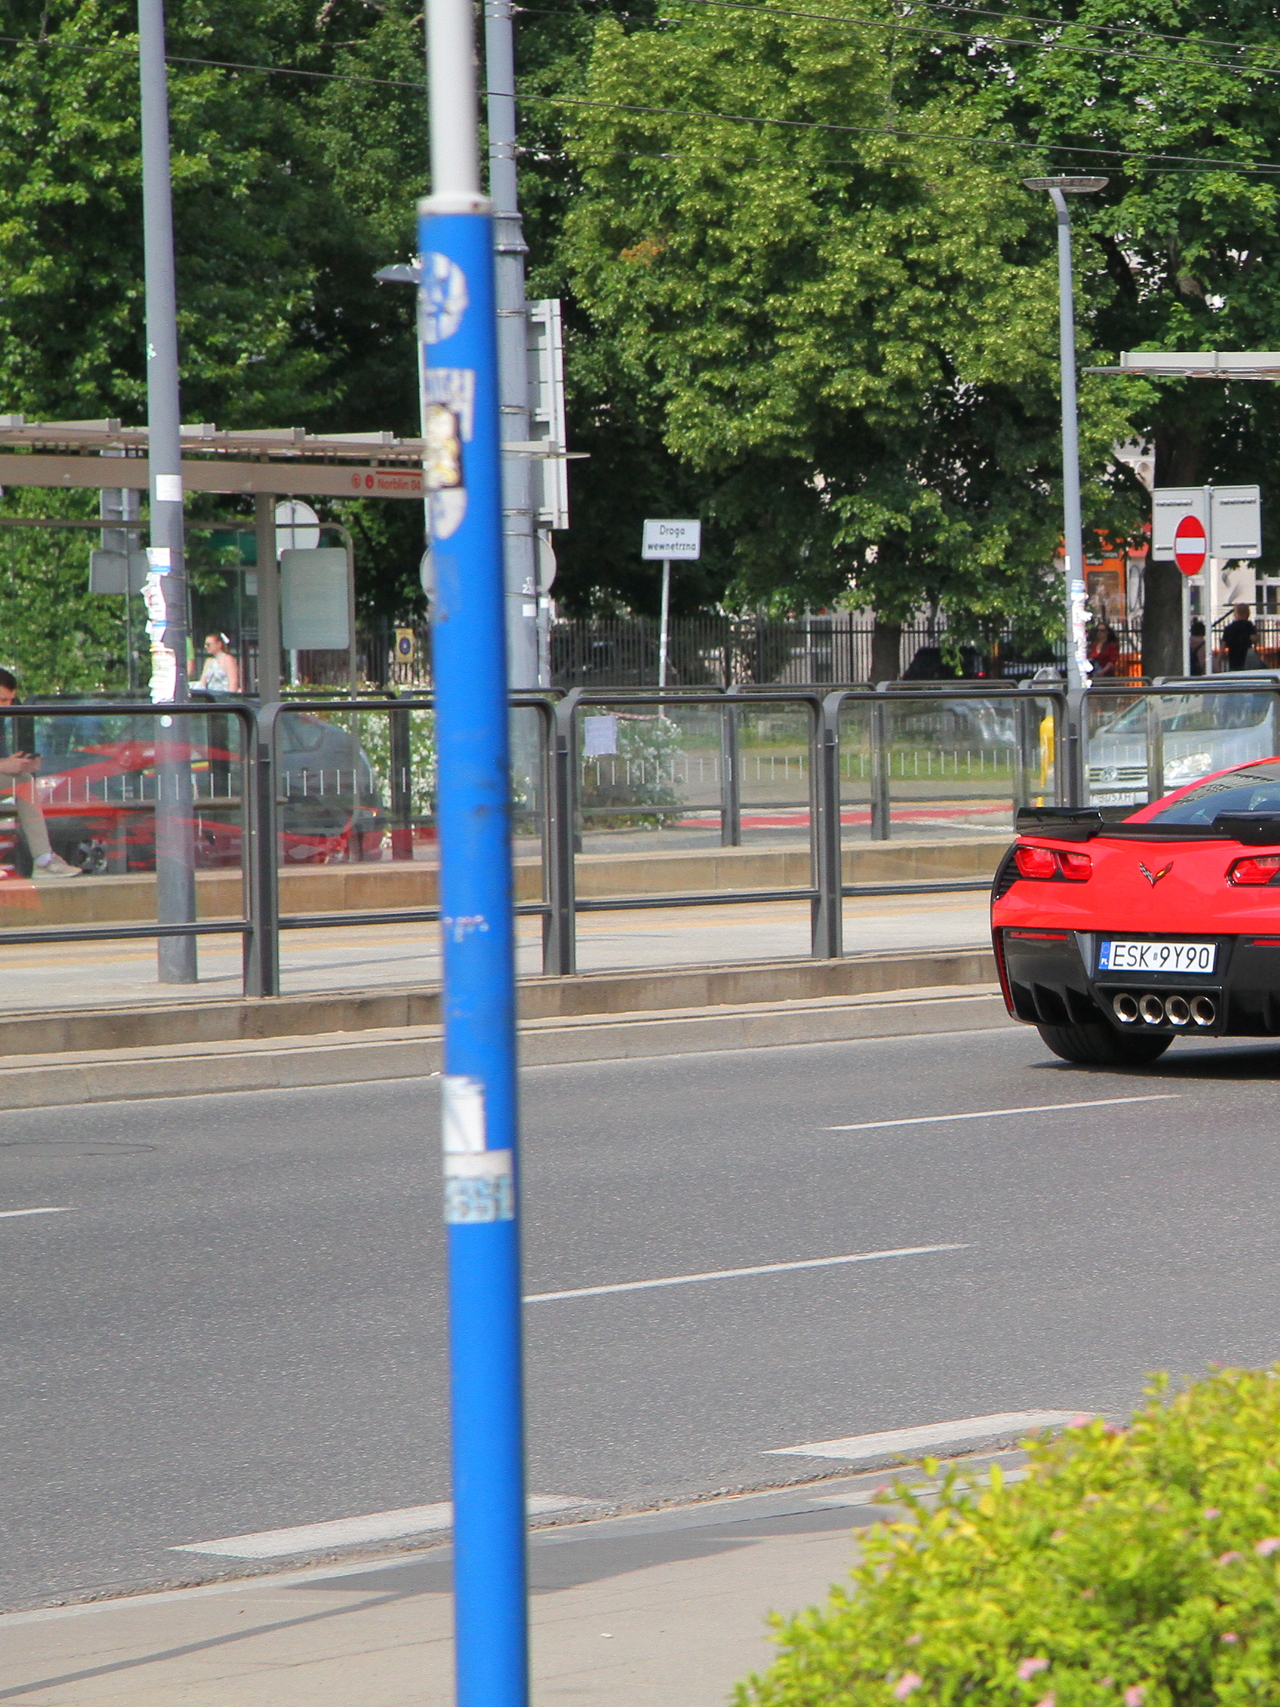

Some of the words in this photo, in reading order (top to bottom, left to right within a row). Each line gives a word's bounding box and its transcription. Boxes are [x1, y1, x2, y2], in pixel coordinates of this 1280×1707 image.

[660, 524, 685, 538] Droga
[648, 542, 696, 553] wewnętrzna
[1113, 944, 1152, 968] ESK
[1159, 946, 1210, 970] 9Y90
